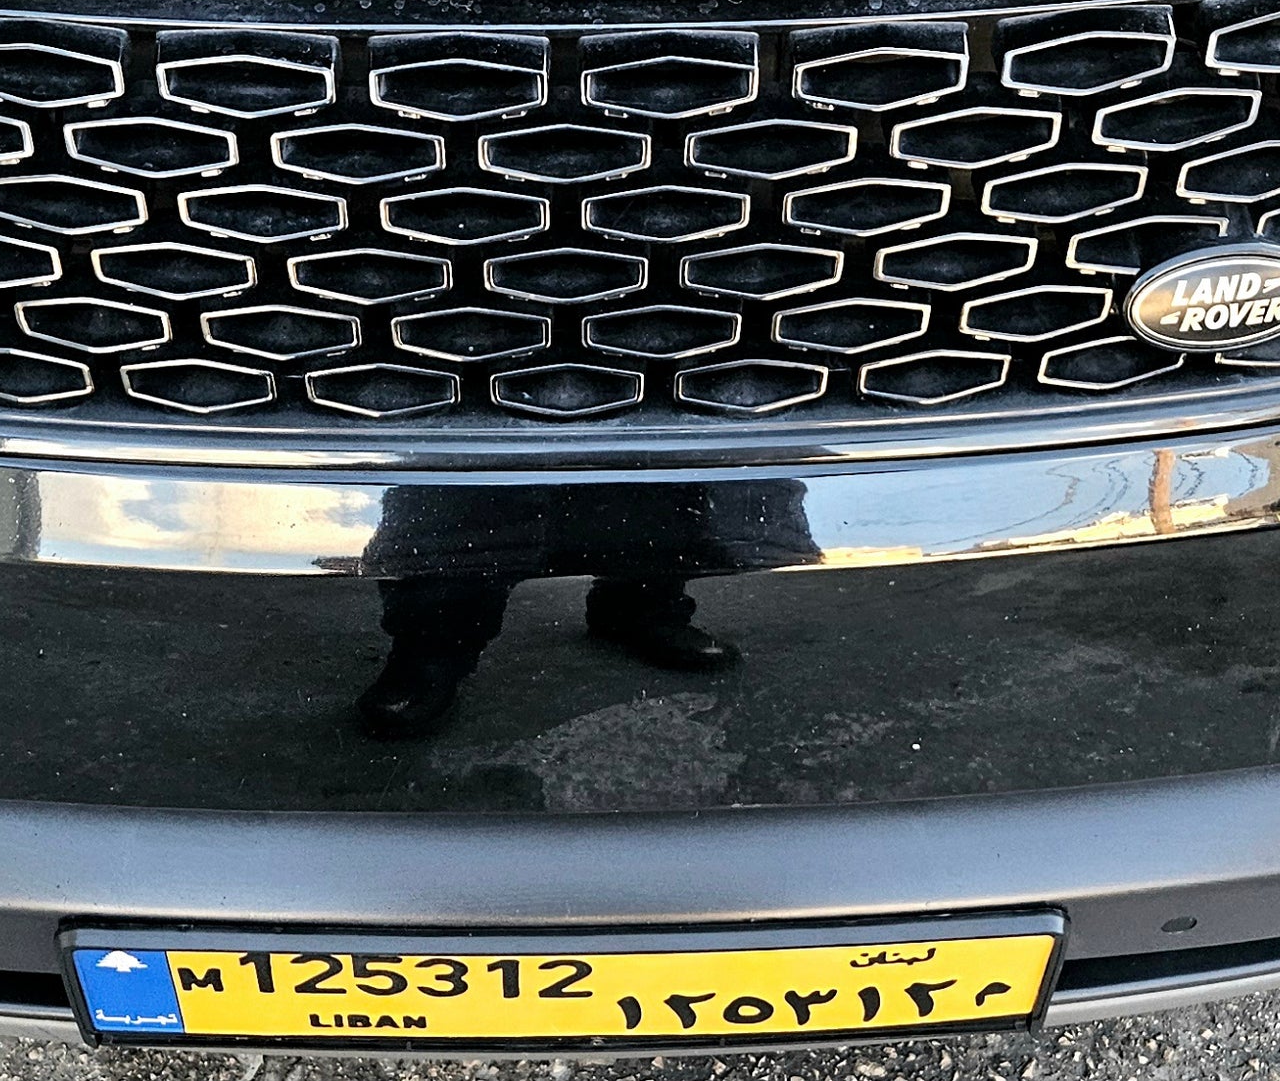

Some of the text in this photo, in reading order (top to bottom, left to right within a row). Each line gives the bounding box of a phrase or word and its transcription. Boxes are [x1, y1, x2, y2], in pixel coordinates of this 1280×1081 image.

[1171, 272, 1262, 307] LAND
[178, 951, 594, 999] M 125312
[849, 947, 937, 968] لبنان
[308, 1013, 427, 1029] LIBAN
[616, 979, 958, 1030] ١٢٥٣١٢
